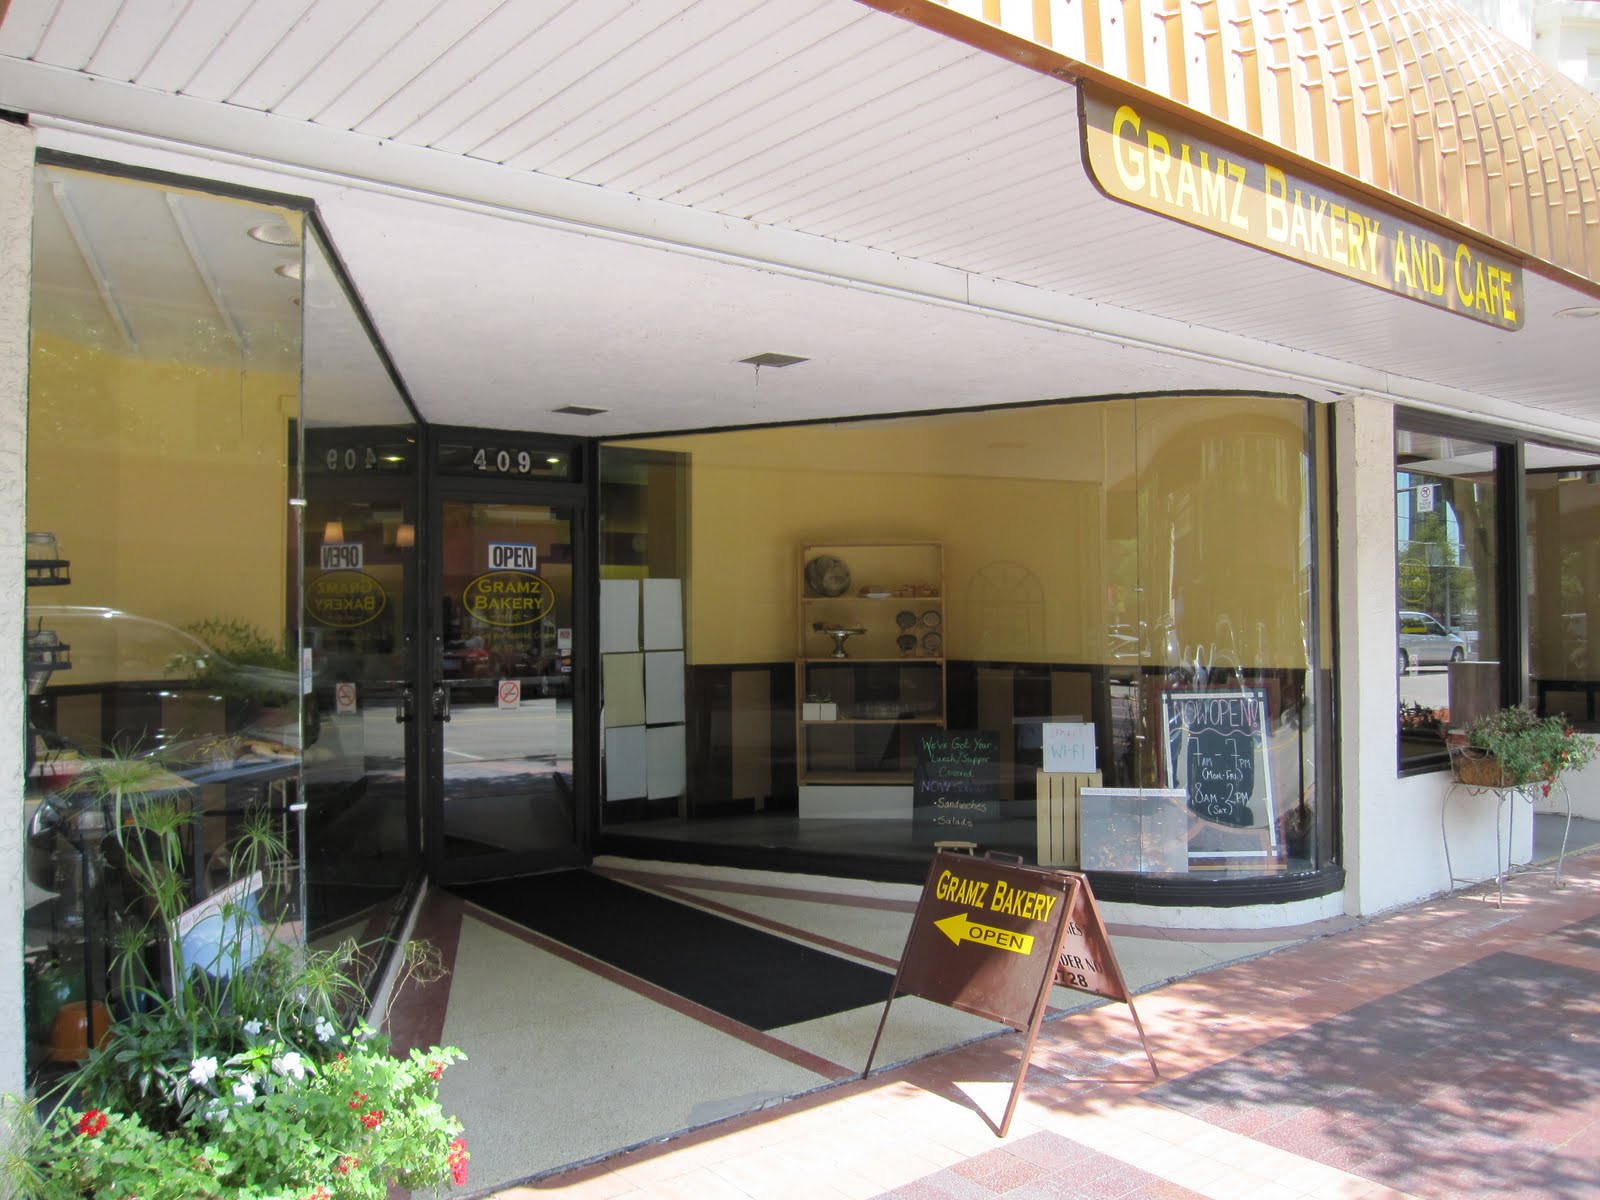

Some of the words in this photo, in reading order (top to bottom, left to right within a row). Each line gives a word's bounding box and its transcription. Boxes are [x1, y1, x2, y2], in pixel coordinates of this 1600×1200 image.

[1112, 104, 1249, 234] GRAMZ
[1264, 163, 1381, 276] BAKERY
[1393, 229, 1444, 297] AND
[1454, 243, 1517, 324] CAFE
[473, 448, 531, 473] 409
[492, 545, 534, 569] OPEN
[477, 578, 541, 594] GRAMZ
[474, 596, 544, 610] BAKERY
[1173, 700, 1208, 726] NOW
[920, 780, 952, 793] NOW
[936, 869, 990, 908] GRAMZ
[990, 880, 1057, 923] BAKERY
[968, 926, 1025, 950] OPEN
[1058, 952, 1085, 970] DER
